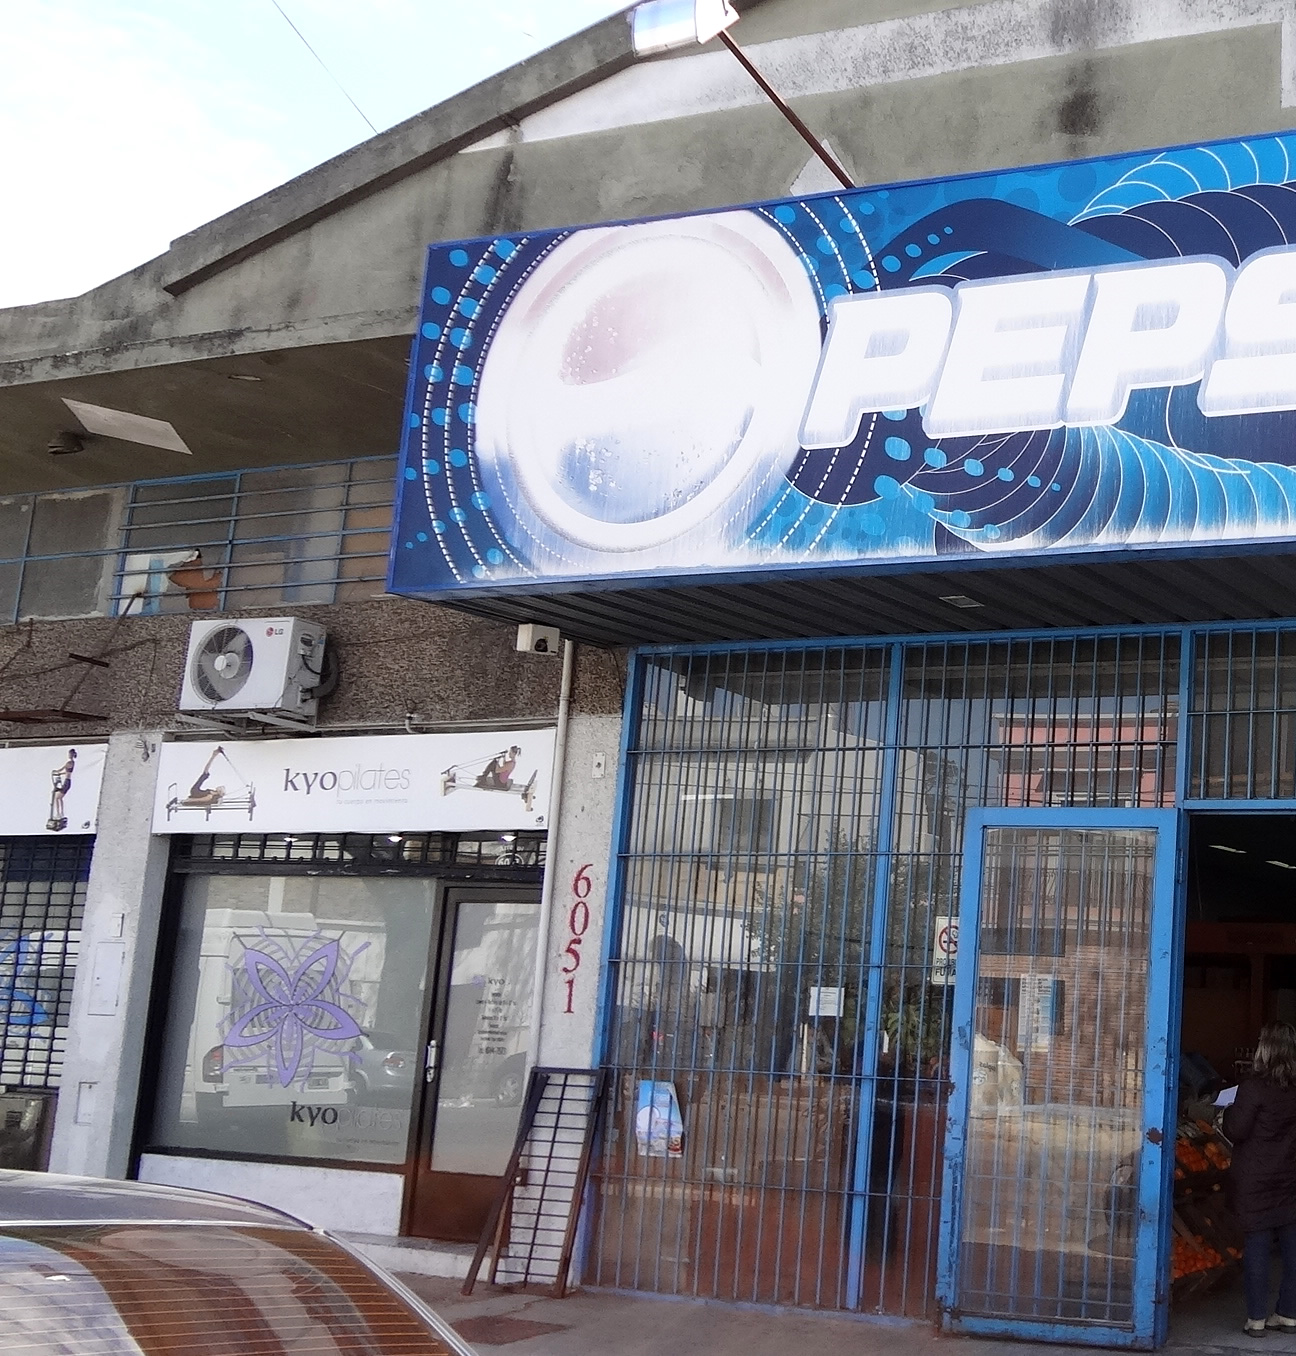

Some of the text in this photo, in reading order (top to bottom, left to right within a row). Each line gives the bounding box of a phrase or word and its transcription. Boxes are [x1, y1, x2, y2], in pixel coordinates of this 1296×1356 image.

[274, 628, 285, 636] LG
[283, 763, 411, 797] kyopilates
[562, 864, 594, 1014] 6051
[935, 967, 957, 976] FUA
